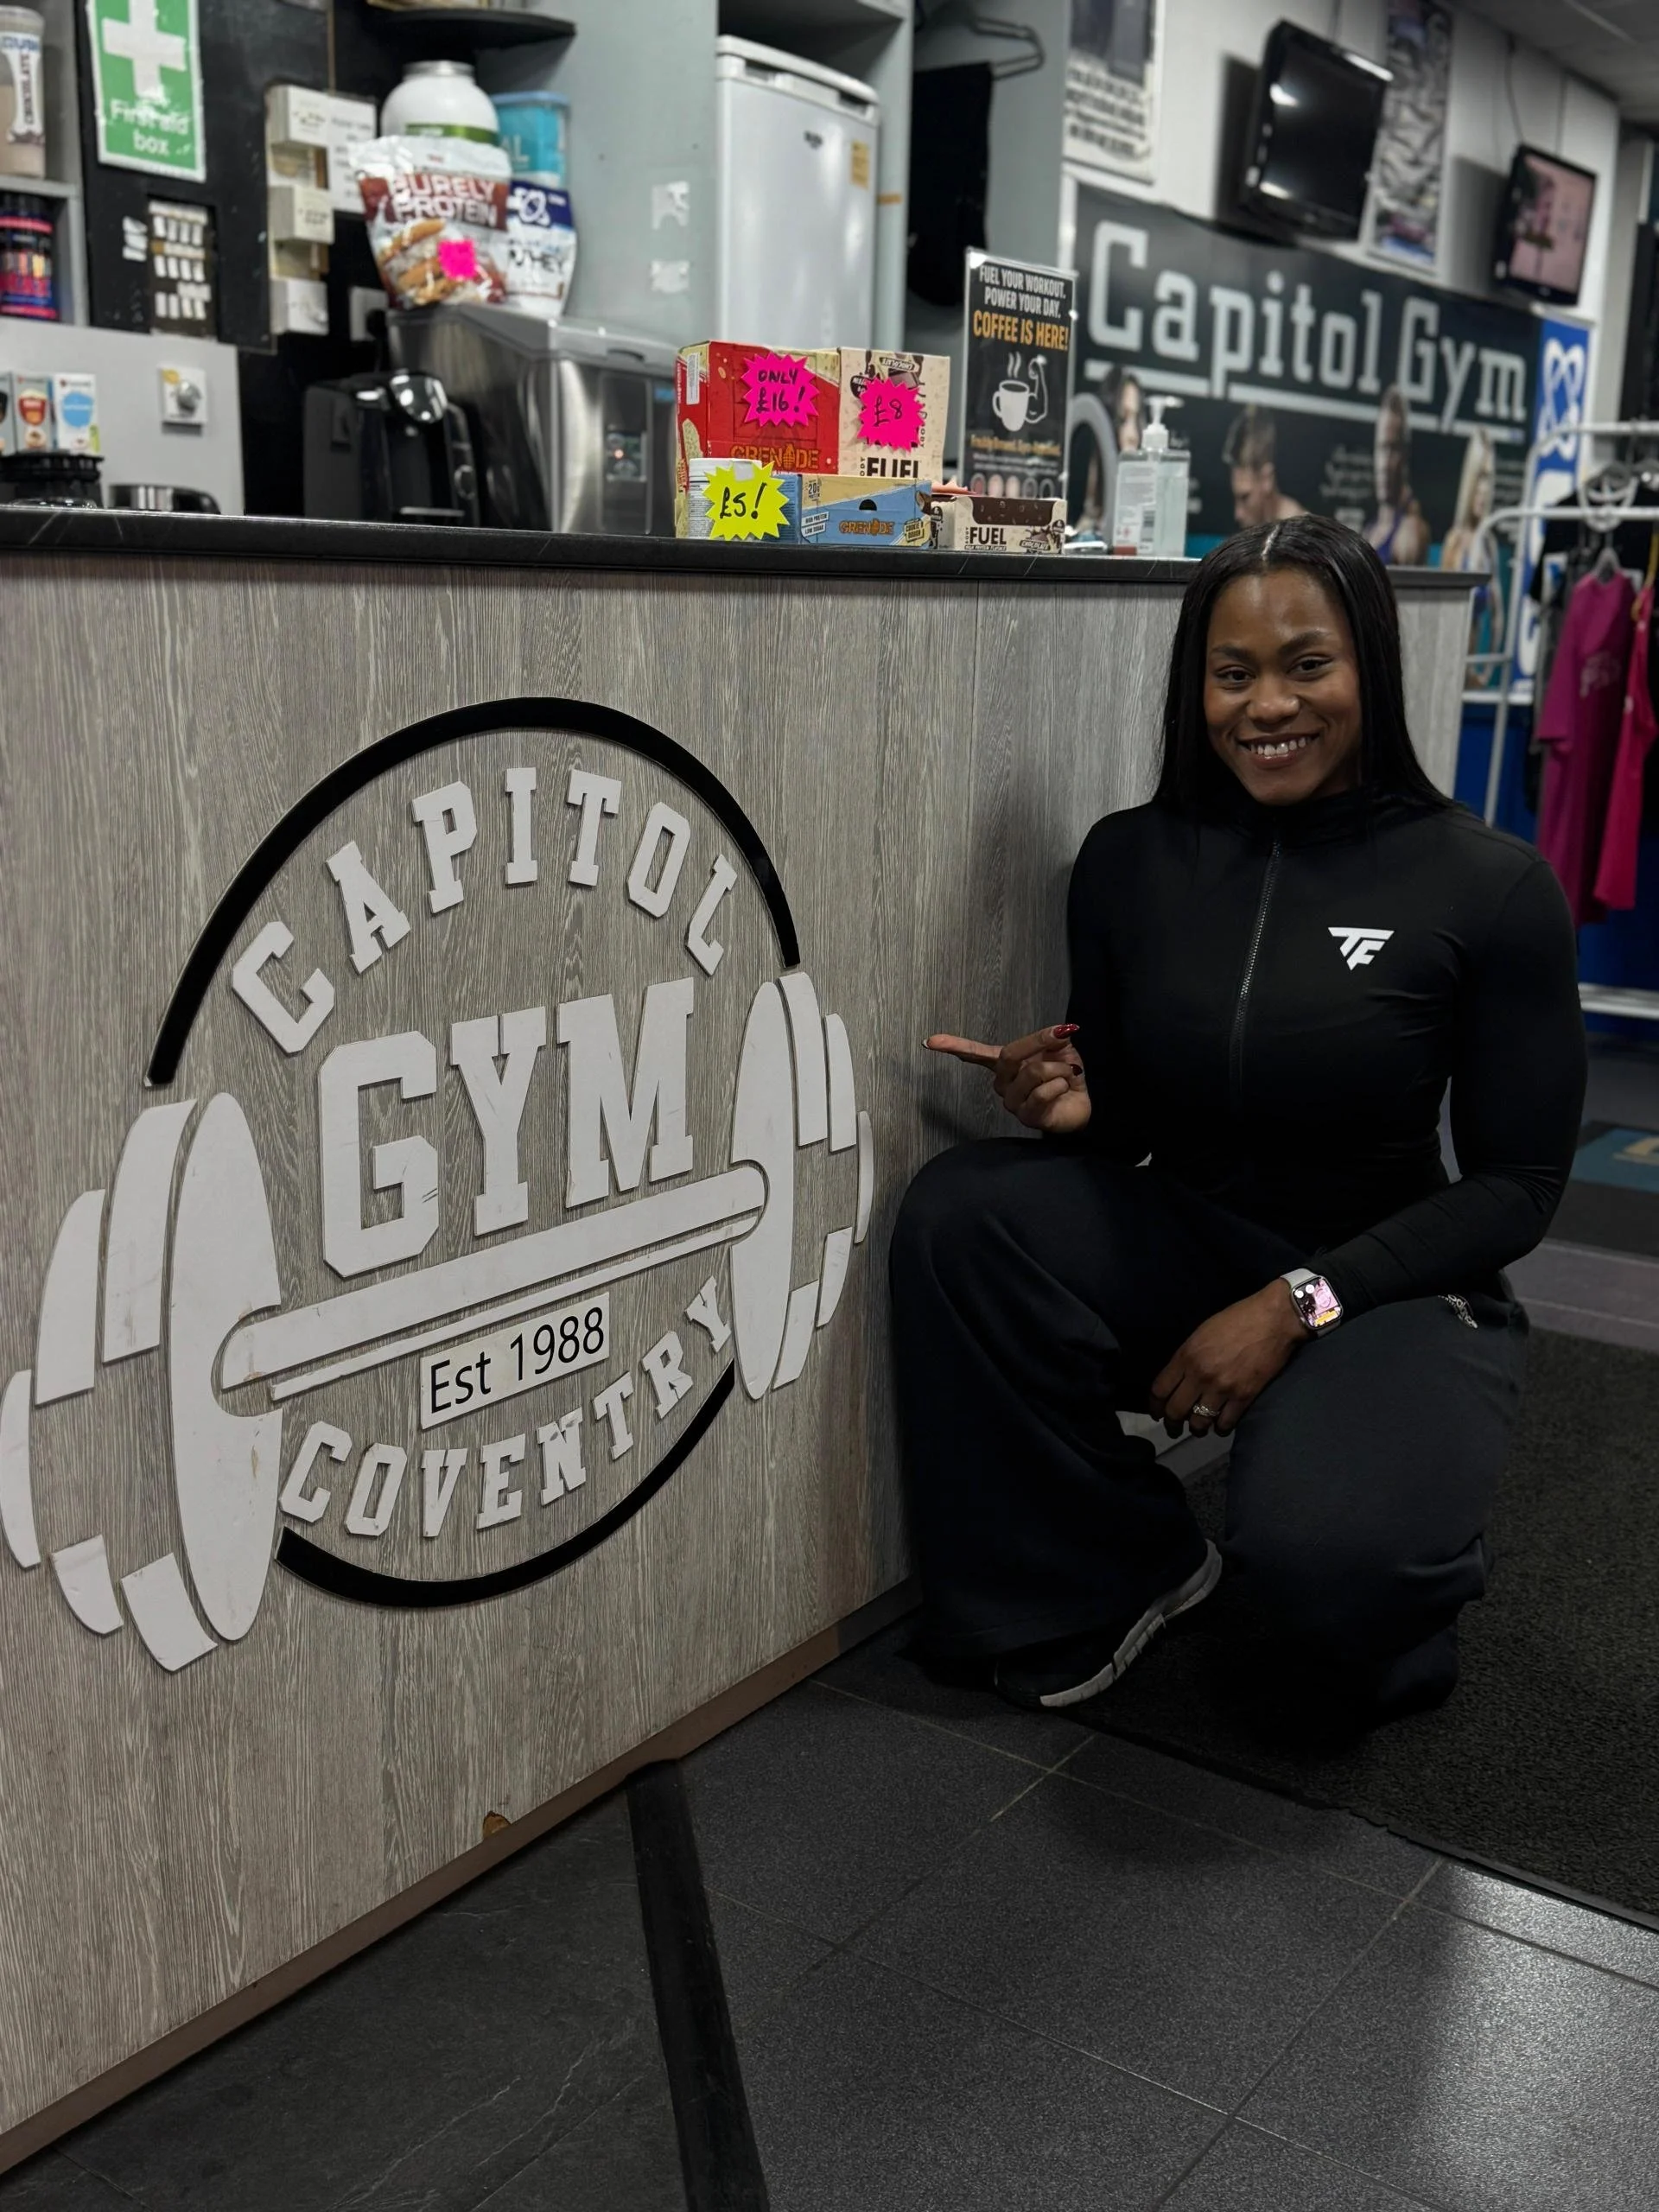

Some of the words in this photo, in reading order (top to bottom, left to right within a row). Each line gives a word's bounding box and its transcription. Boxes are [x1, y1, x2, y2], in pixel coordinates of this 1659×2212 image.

[133, 129, 169, 156] box
[392, 194, 498, 227] PROTEIN
[979, 264, 1000, 285] FUEL
[1001, 268, 1024, 290] YOUR
[1025, 273, 1066, 299] WORKOUT.
[984, 286, 1017, 310] POWER
[1019, 293, 1042, 315] YOUR
[1043, 298, 1062, 319] DAY.
[973, 309, 1019, 342] COFFEE
[1020, 318, 1034, 345] IS
[1036, 321, 1069, 351] HERE!
[1088, 219, 1382, 398] Capitol
[1397, 296, 1527, 433] Gym
[757, 368, 798, 385] ONLY
[873, 395, 903, 427] £8
[838, 518, 895, 536] GRENADE
[969, 526, 1007, 545] FUEL
[232, 767, 738, 1053] CAPITOL
[320, 977, 693, 1277] GYM
[430, 1351, 492, 1414] Est
[510, 1306, 605, 1382] 1988
[278, 1276, 733, 1537] COVENTRY
